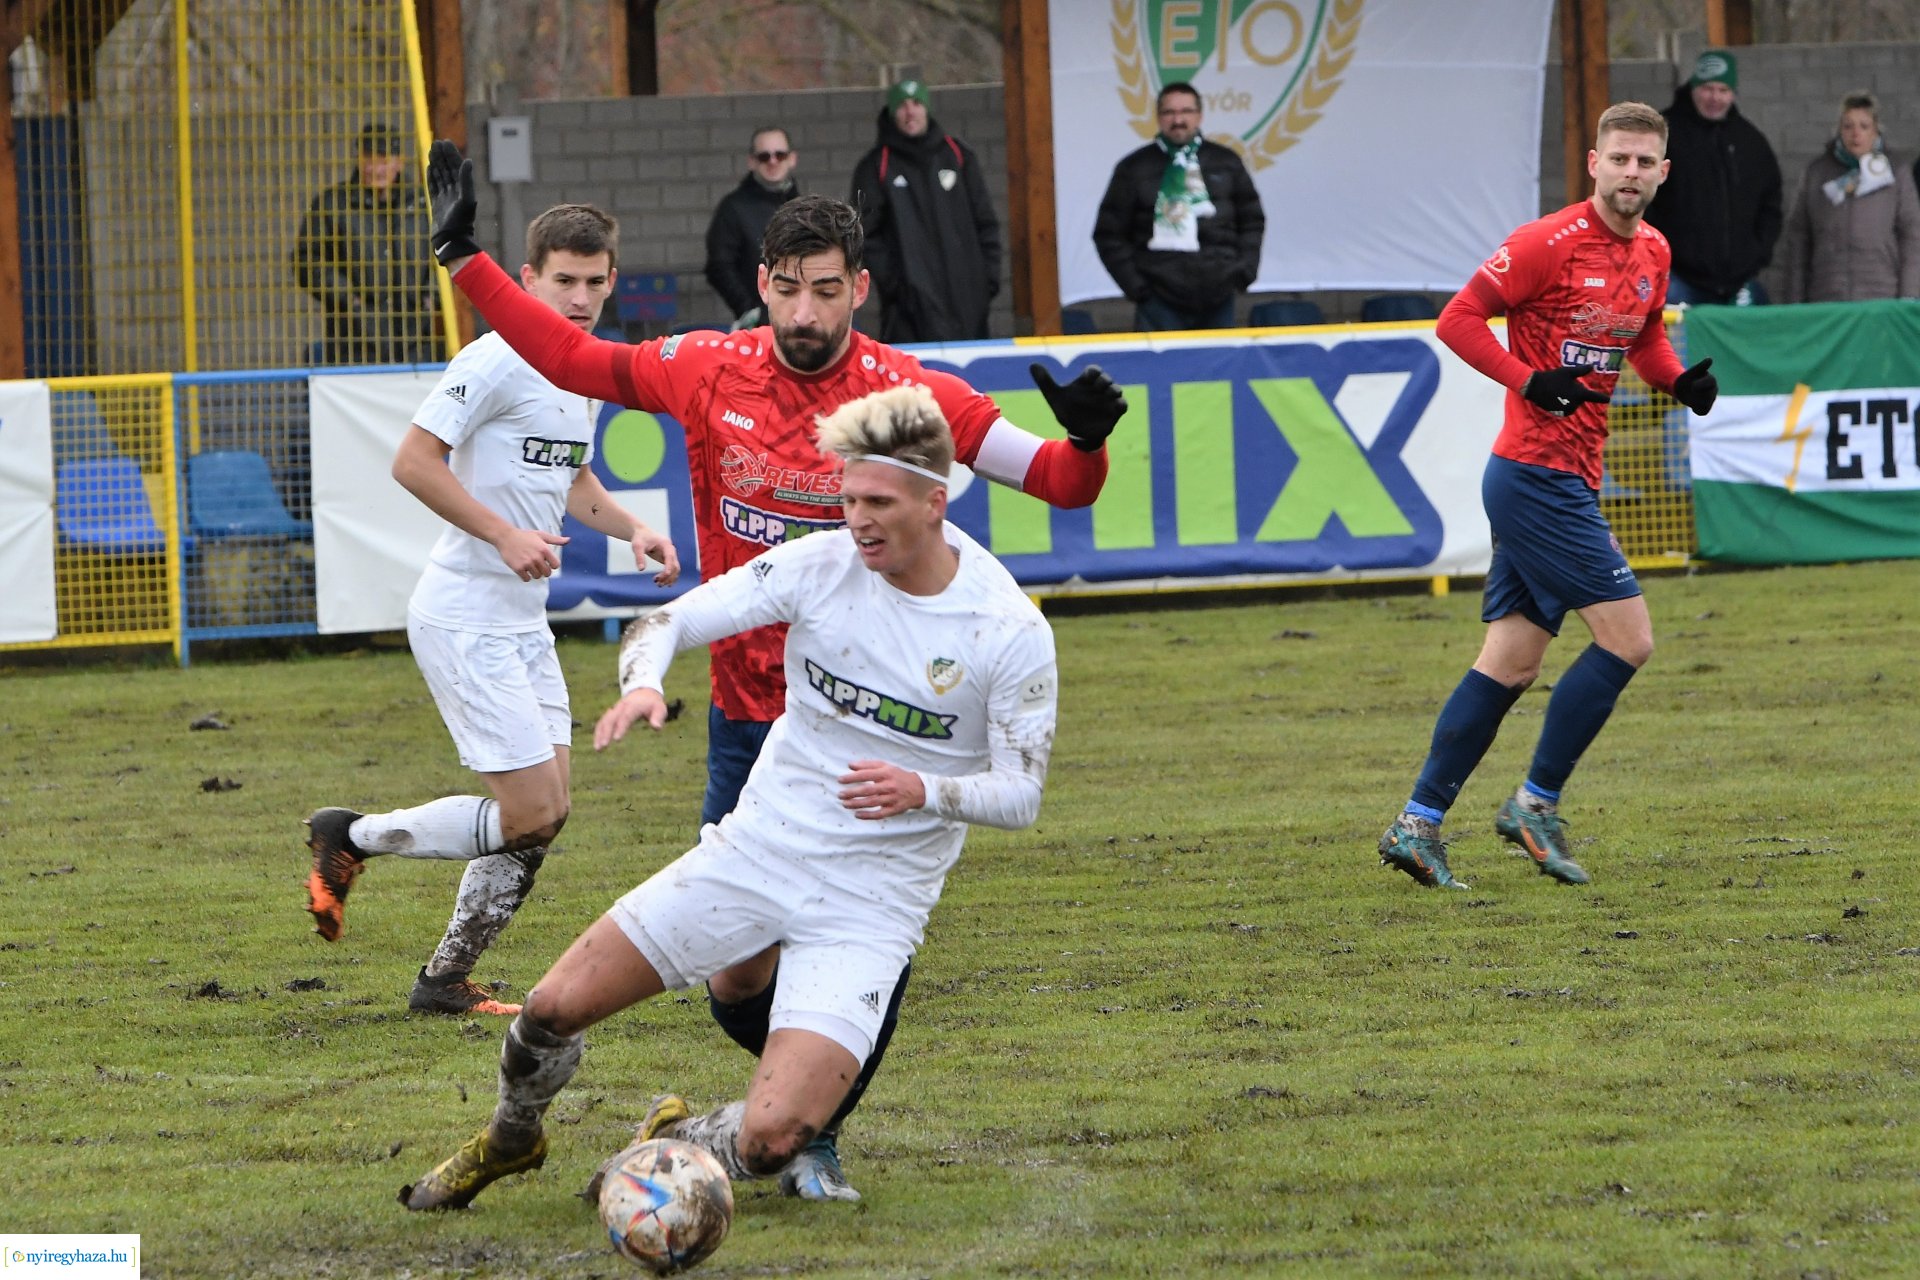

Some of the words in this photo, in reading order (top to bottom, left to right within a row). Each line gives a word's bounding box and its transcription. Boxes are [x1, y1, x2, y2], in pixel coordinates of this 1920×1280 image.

[721, 410, 755, 431] JAKO
[1826, 399, 1920, 480] ET
[805, 658, 959, 739] TiPPMIX
